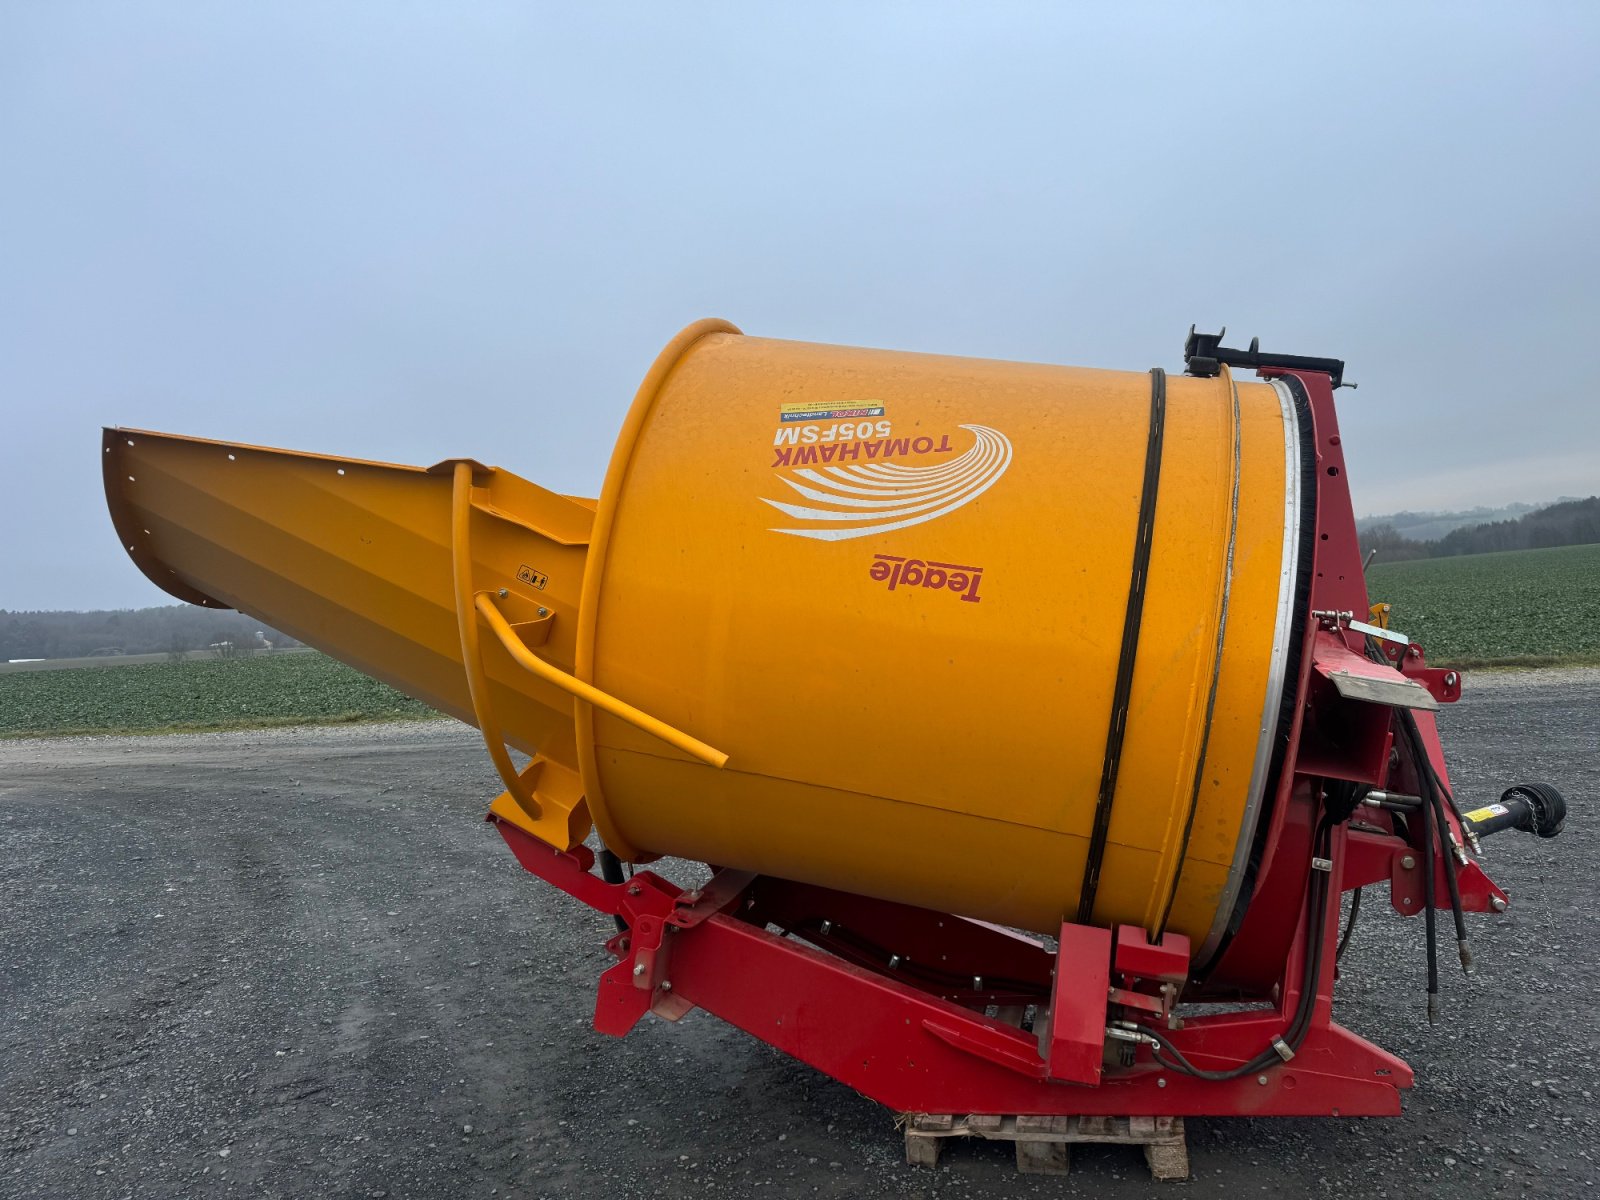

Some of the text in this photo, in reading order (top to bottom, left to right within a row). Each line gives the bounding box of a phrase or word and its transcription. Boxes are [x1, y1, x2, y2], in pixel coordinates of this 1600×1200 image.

[773, 420, 892, 446] 505FSM
[771, 434, 953, 468] TOMAHAWK
[869, 556, 984, 603] Teagle
